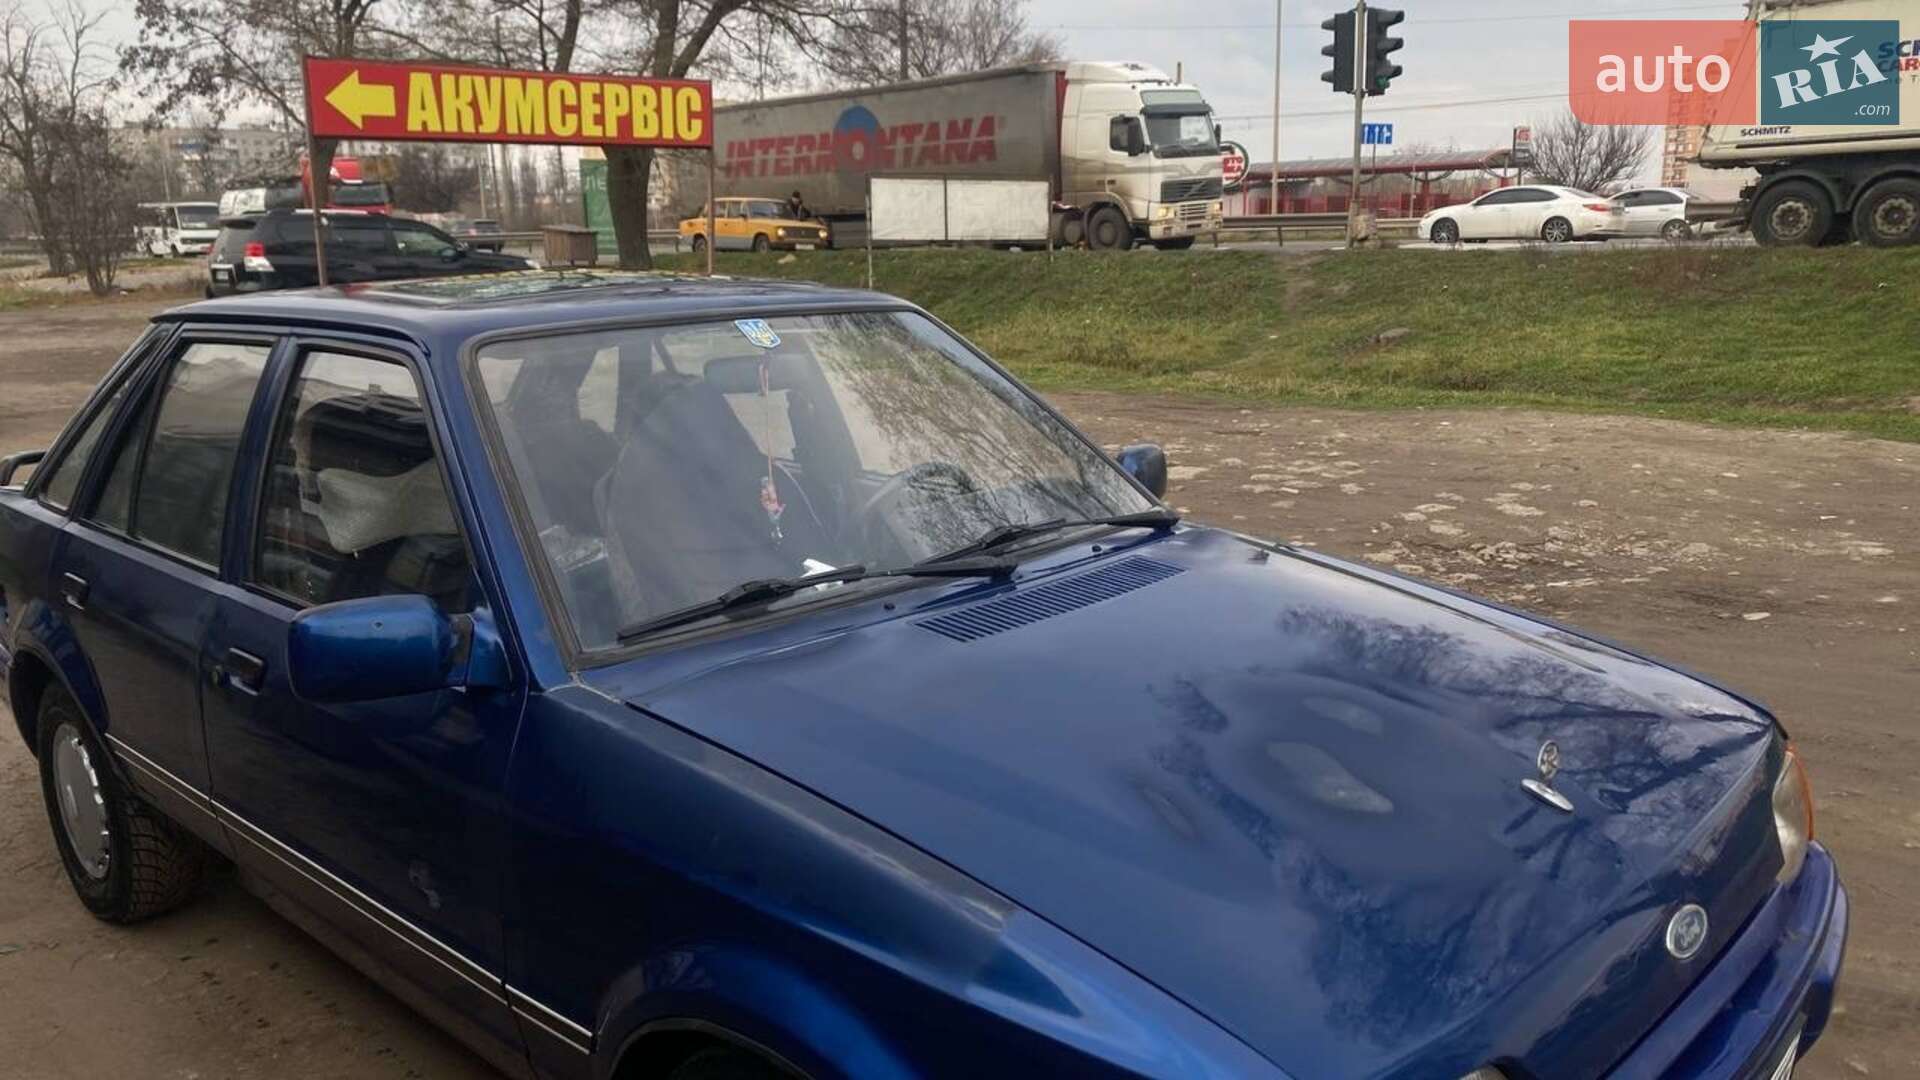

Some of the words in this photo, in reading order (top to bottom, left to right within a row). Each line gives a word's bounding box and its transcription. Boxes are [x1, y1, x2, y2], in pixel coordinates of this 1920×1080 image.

[1879, 58, 1920, 72] CAR
[407, 71, 702, 142] АКУМСЕРВІС
[724, 115, 997, 178] INTERMONTANA
[1741, 126, 1791, 136] SCHMITZ
